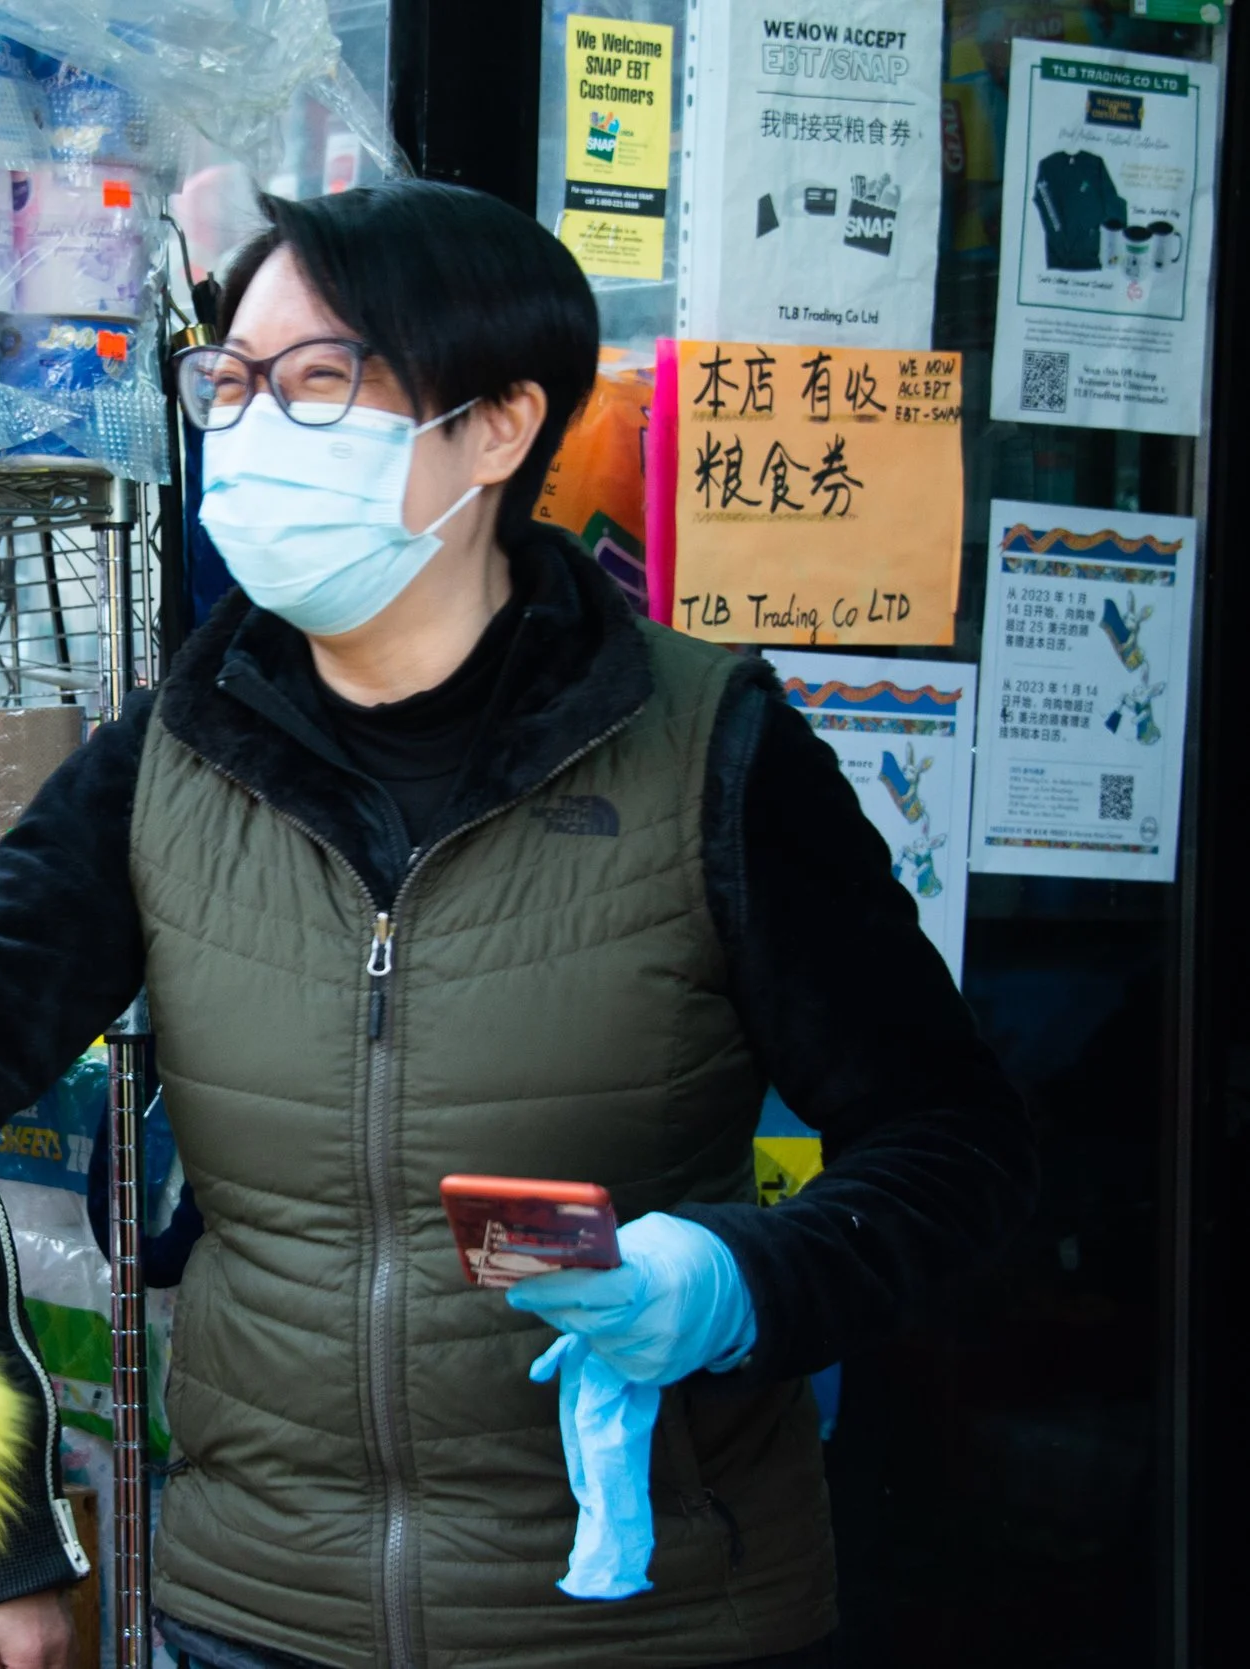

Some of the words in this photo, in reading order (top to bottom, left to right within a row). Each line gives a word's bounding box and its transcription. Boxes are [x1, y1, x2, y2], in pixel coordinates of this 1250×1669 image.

[576, 30, 596, 50] We
[602, 33, 662, 58] Welcome
[843, 28, 907, 50] ACCEPT
[586, 55, 622, 76] SNAP
[627, 60, 651, 81] EBT
[762, 44, 910, 85] EBT/SNAP
[1052, 64, 1077, 79] TLB
[1081, 69, 1131, 86] TRADING
[1133, 75, 1150, 88] CO
[1153, 78, 1178, 91] LTD
[580, 79, 654, 106] Customers
[586, 136, 615, 152] SNAP
[845, 216, 895, 239] SNAP
[778, 306, 800, 321] TLB
[803, 307, 842, 326] Trading
[845, 310, 859, 324] Co
[862, 310, 879, 325] Ltd
[899, 357, 917, 377] WE
[925, 358, 956, 375] NOW
[898, 380, 951, 400] ACCEPT
[695, 431, 864, 517] 粮食券
[1021, 588, 1050, 602] 2023
[680, 594, 731, 630] TLB
[747, 593, 822, 646] Trading
[832, 597, 859, 628] Co
[868, 588, 911, 622] LTD
[1007, 603, 1018, 614] 14
[1029, 620, 1043, 633] 25
[1016, 680, 1044, 694] 2023
[1086, 685, 1098, 697] 14
